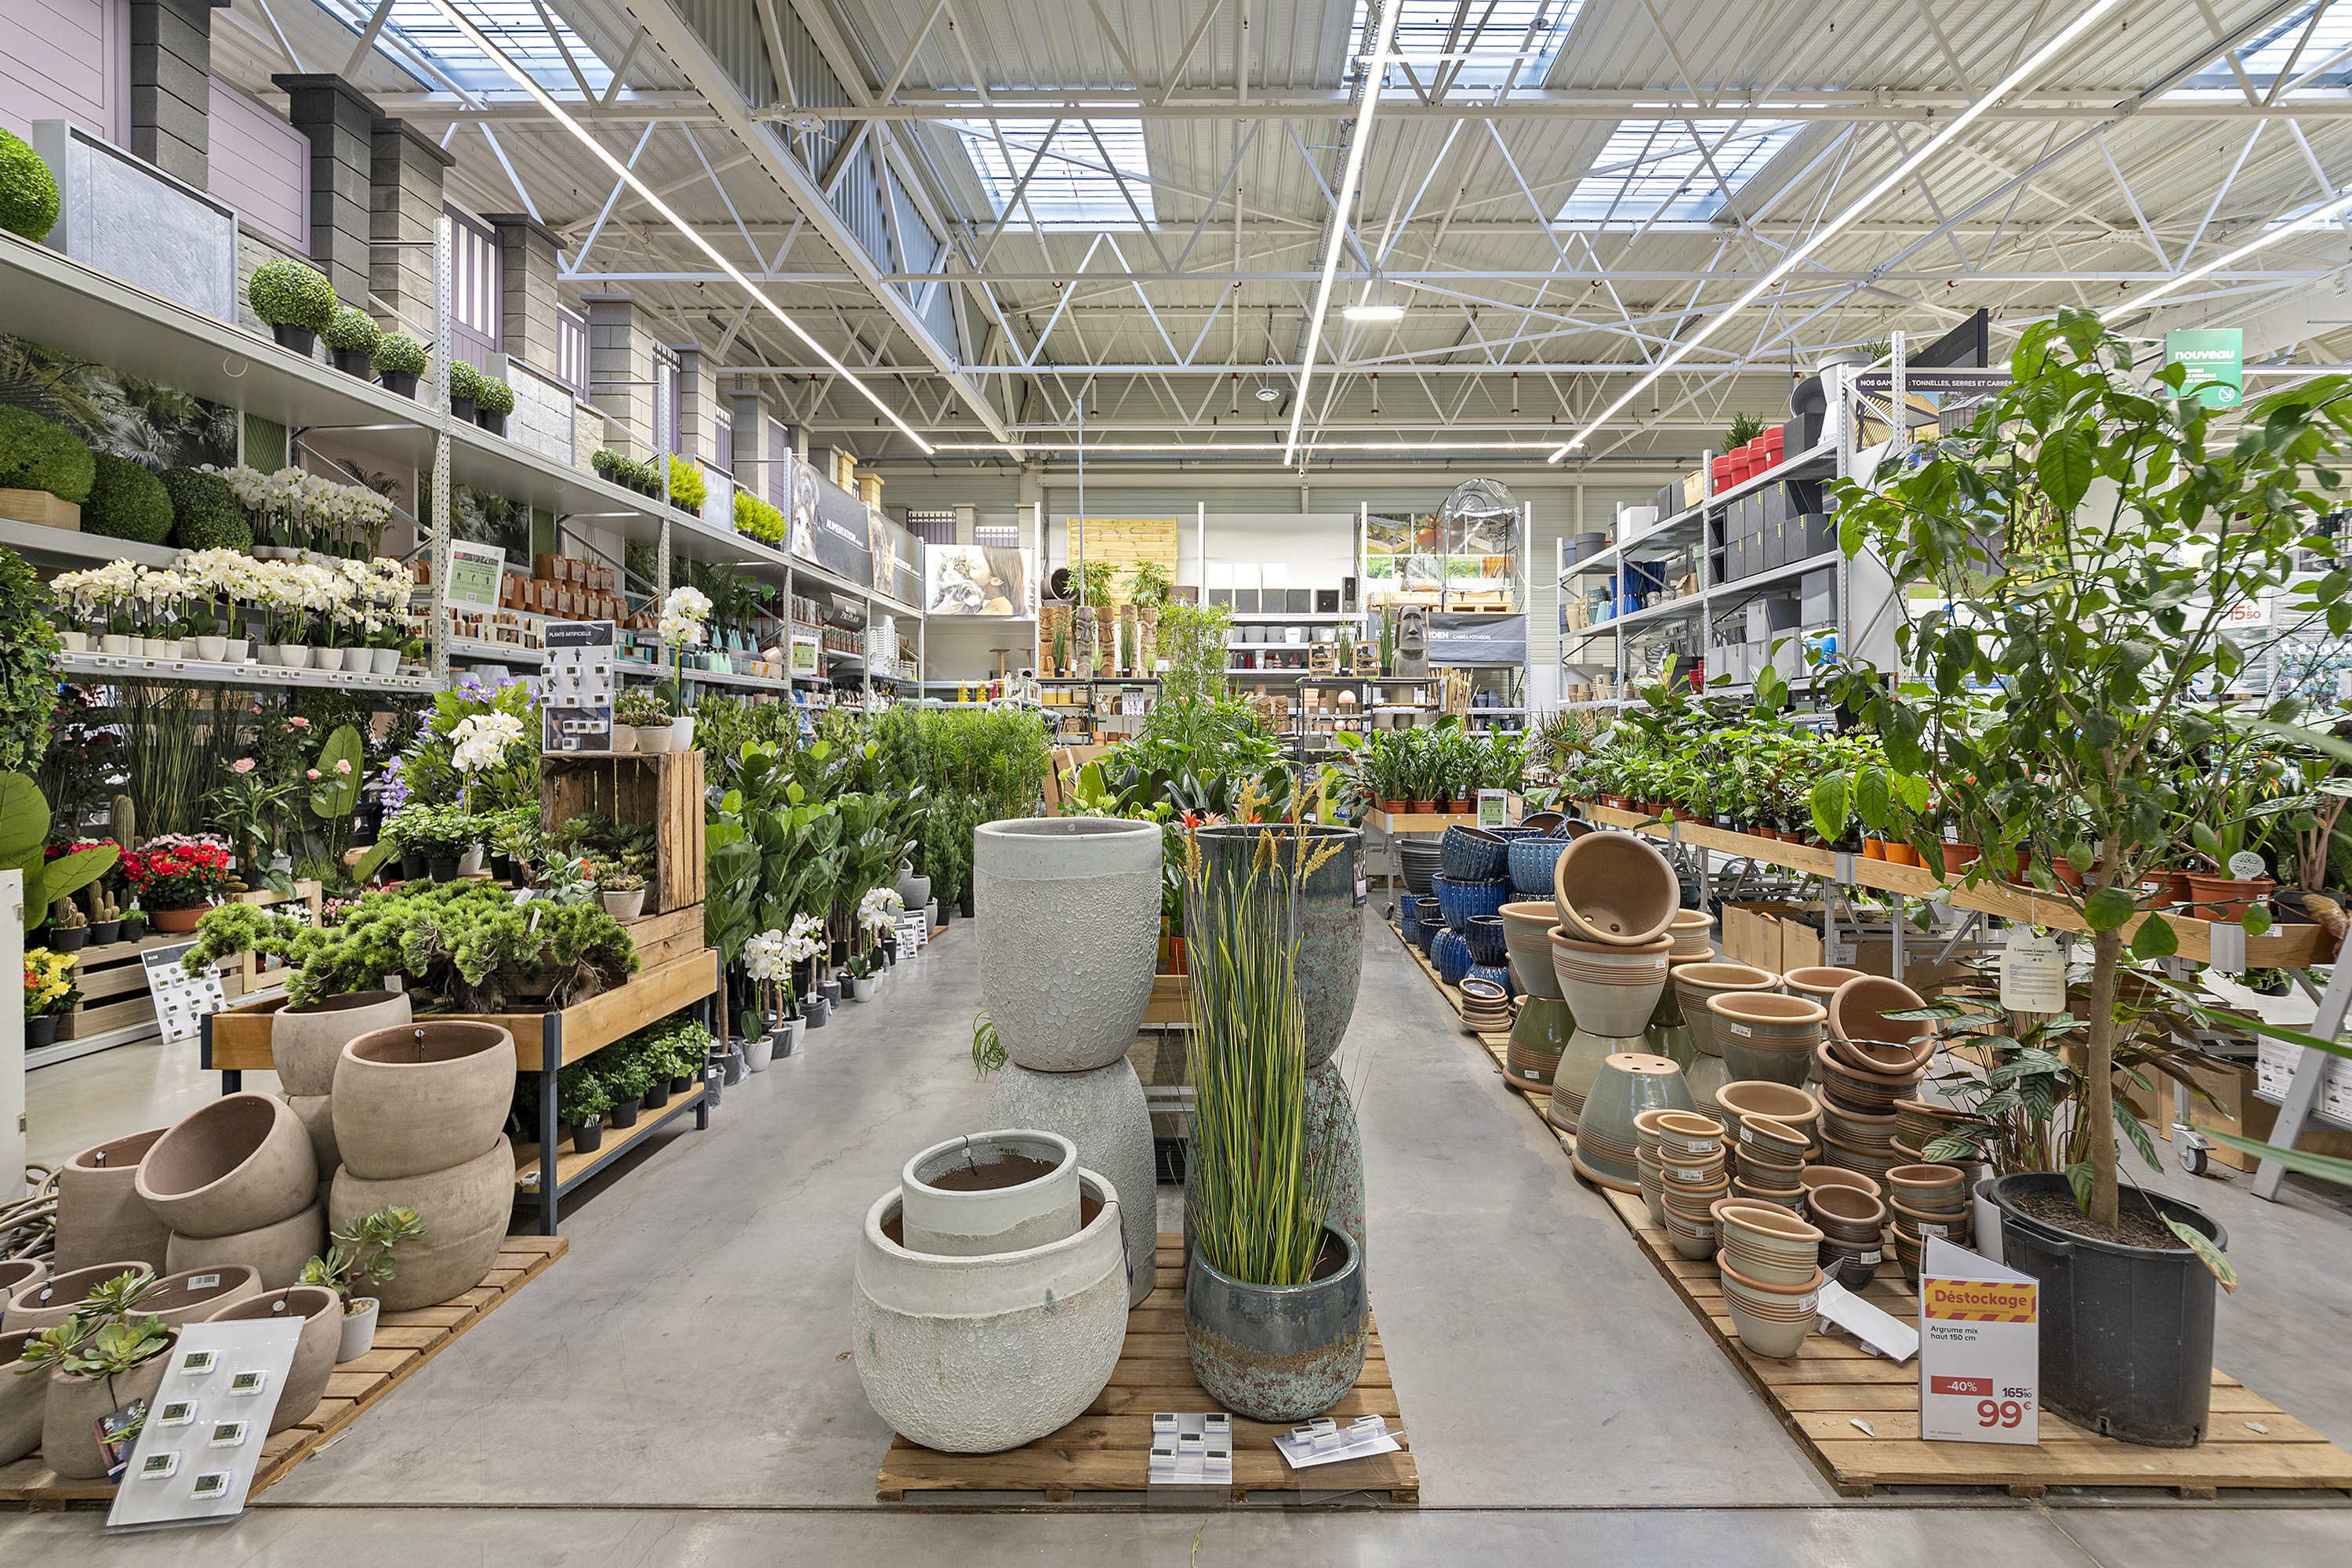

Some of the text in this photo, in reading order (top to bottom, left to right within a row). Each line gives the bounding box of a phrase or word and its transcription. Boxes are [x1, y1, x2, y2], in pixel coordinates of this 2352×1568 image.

[2175, 350, 2235, 360] nouveau
[826, 518, 856, 543] ALIMENTATION
[1934, 1289, 2027, 1309] Déstockage
[1930, 1325, 1963, 1334] Argrume
[1947, 1381, 1977, 1392] -40%
